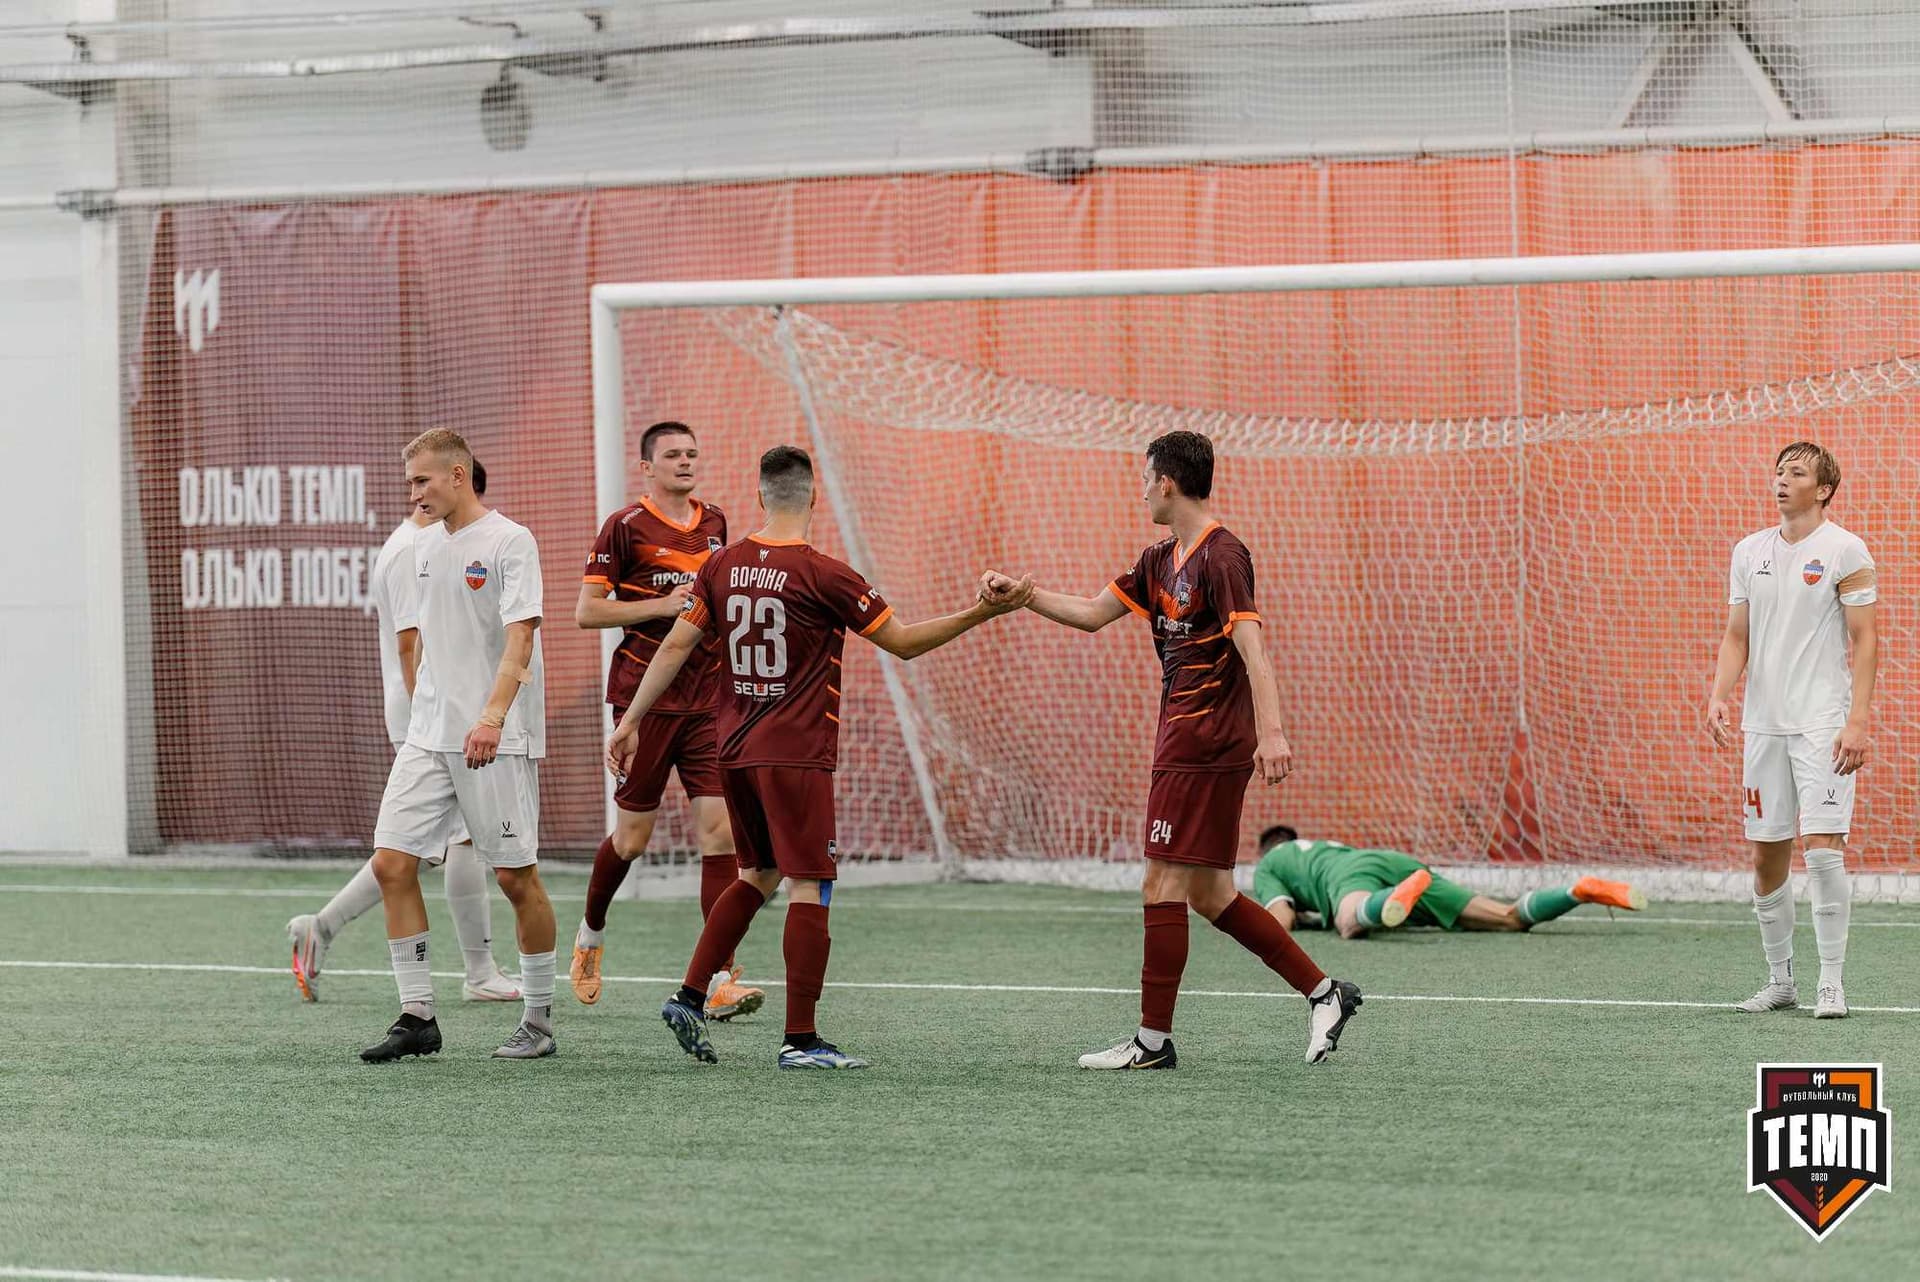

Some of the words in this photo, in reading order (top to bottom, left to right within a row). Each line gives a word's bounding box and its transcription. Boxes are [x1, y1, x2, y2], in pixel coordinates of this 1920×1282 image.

[179, 465, 281, 527] ОЛЬКО
[289, 465, 377, 531] ТЕМП,
[181, 547, 283, 610] ОЛЬКО
[730, 566, 788, 592] ВОРОНА
[727, 594, 788, 678] 23
[733, 680, 787, 697] SEUS
[1150, 819, 1172, 845] 24
